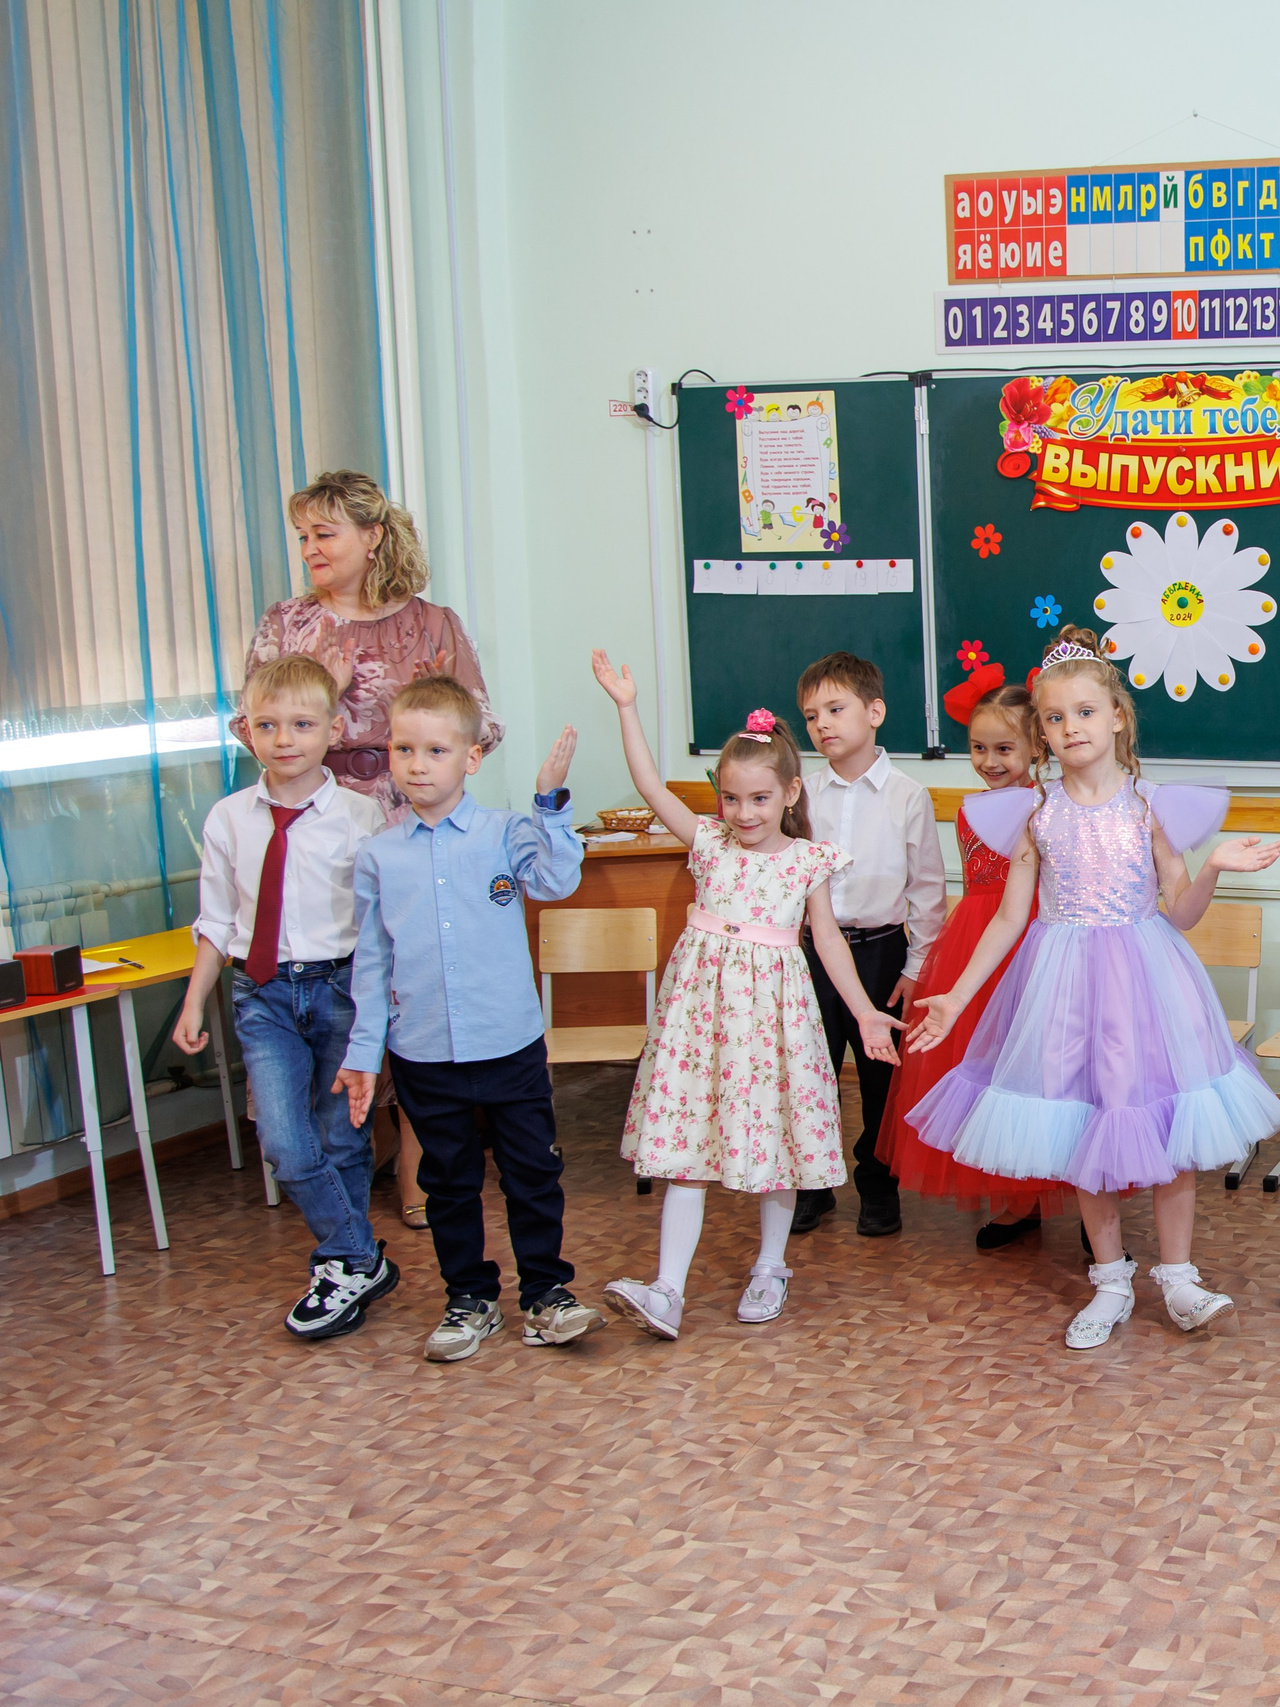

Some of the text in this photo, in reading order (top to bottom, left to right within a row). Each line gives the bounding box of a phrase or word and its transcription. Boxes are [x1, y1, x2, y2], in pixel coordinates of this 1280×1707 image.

[948, 307, 963, 340] 0
[972, 306, 982, 338] 1
[993, 305, 1008, 338] 2
[1016, 304, 1030, 338] 3
[1038, 303, 1053, 336] 4
[1061, 303, 1074, 336] 5
[1082, 301, 1098, 335] 6
[1106, 301, 1121, 334] 7
[1129, 300, 1145, 334] 8
[1152, 299, 1168, 333] 9
[1174, 298, 1196, 333] 10
[1201, 298, 1220, 331] 11
[1226, 297, 1247, 331] 12
[1253, 296, 1275, 330] 13
[613, 404, 628, 412] 220
[1068, 378, 1193, 443] Удачи
[1170, 613, 1192, 621] 2024
